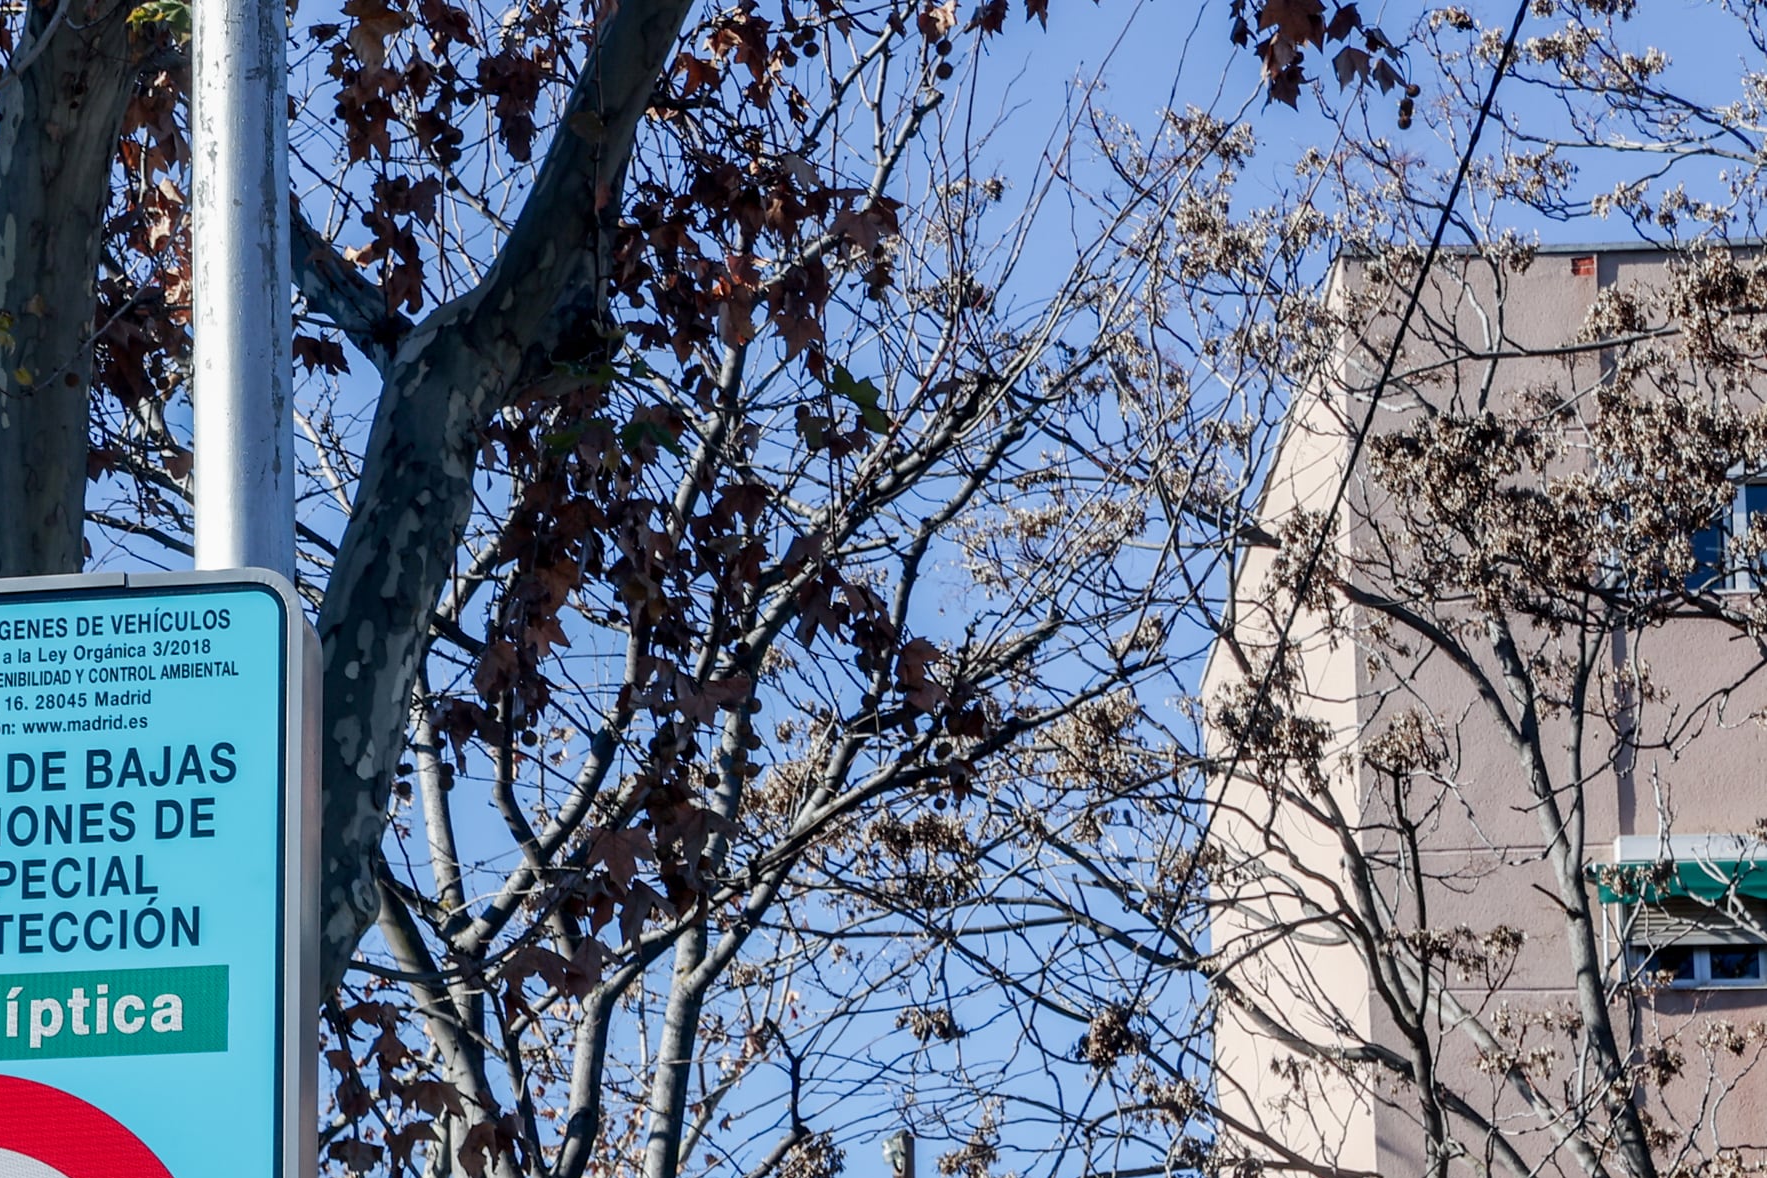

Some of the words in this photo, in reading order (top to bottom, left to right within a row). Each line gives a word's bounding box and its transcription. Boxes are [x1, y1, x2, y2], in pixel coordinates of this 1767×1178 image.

[76, 615, 104, 637] DE
[110, 606, 231, 635] VEHÍCULOS
[2, 652, 12, 665] a
[17, 647, 32, 664] la
[38, 647, 68, 665] Ley
[73, 642, 147, 664] Orgánica
[152, 638, 211, 657] 3/2018
[74, 668, 85, 685] Y
[88, 664, 157, 684] CONTROL
[159, 660, 240, 680] AMBIENTAL
[4, 695, 29, 712] 16.
[34, 692, 88, 710] 28045
[94, 688, 152, 707] Madrid
[21, 713, 148, 735] www.madrid.es
[6, 750, 67, 794] DE
[85, 741, 237, 790] BAJAS
[154, 796, 216, 841] DE
